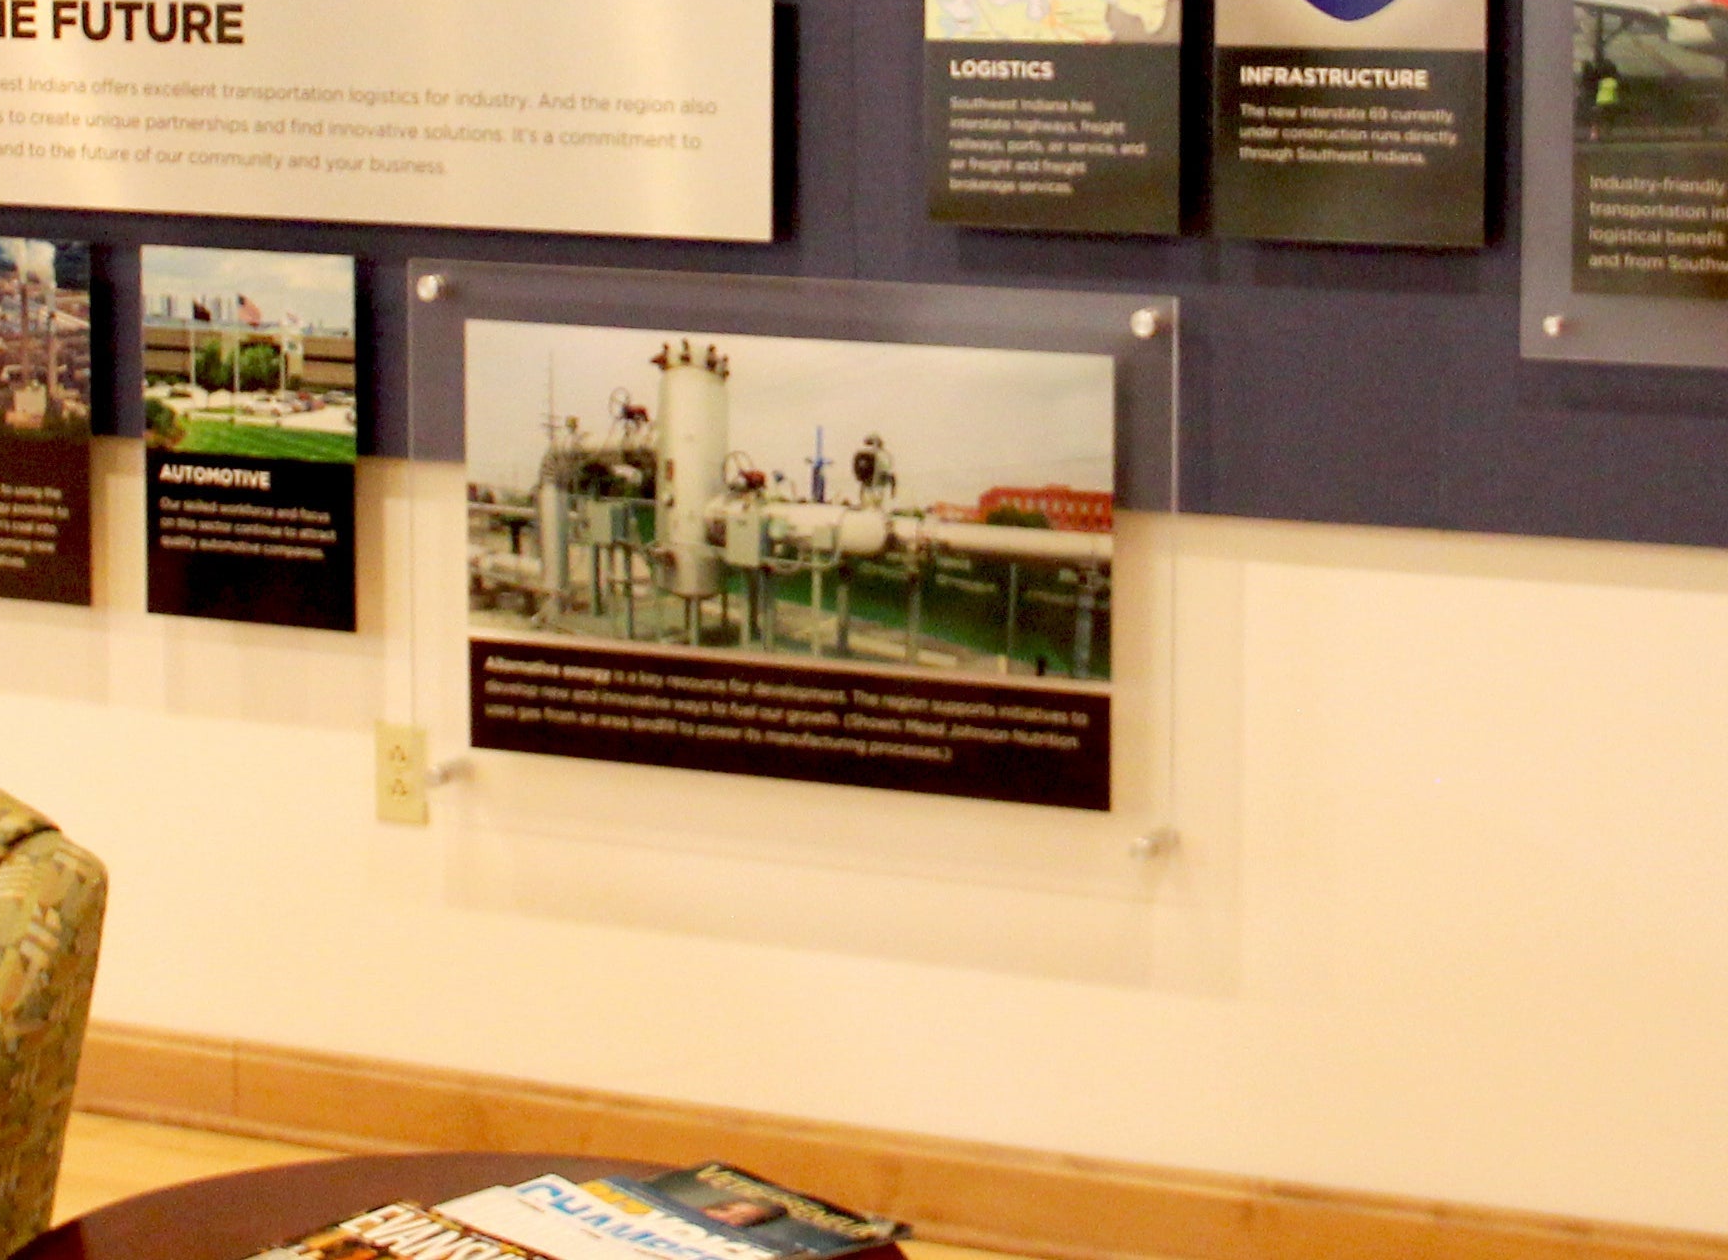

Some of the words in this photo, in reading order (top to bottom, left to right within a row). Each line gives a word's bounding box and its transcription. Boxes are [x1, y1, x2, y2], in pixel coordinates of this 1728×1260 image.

[52, 0, 244, 44] FUTURE
[949, 59, 1054, 80] LOGISTICS
[1239, 65, 1428, 88] INFRASTRUCTURE
[28, 79, 87, 92] Indiana
[91, 79, 139, 94] offers
[142, 84, 217, 97] excellent
[222, 85, 344, 100] transportation
[349, 90, 419, 105] logistics
[425, 89, 450, 104] for
[538, 94, 576, 108] And
[581, 96, 611, 110] the
[616, 99, 674, 114] region
[680, 102, 717, 113] also
[8, 110, 27, 125] to
[29, 111, 81, 126] create
[85, 114, 142, 129] unique
[144, 115, 250, 134] partnerships
[253, 119, 286, 134] and
[289, 117, 325, 136] find
[327, 123, 419, 139] innovative
[542, 131, 555, 145] a
[558, 131, 677, 147] commitment
[681, 134, 703, 149] to
[27, 143, 47, 158] to
[49, 143, 77, 158] the
[80, 144, 131, 161] future
[133, 146, 153, 162] of
[154, 149, 184, 164] our
[187, 151, 283, 169] community
[287, 155, 321, 170] and
[325, 157, 365, 171] your
[1589, 176, 1726, 197] Industry-friendly
[1589, 202, 1709, 220] transportation
[1588, 227, 1663, 244] logistical
[1665, 229, 1725, 246] benefit
[1588, 254, 1621, 269] and
[1624, 254, 1665, 269] from
[159, 463, 272, 490] AUTOMOTIVE
